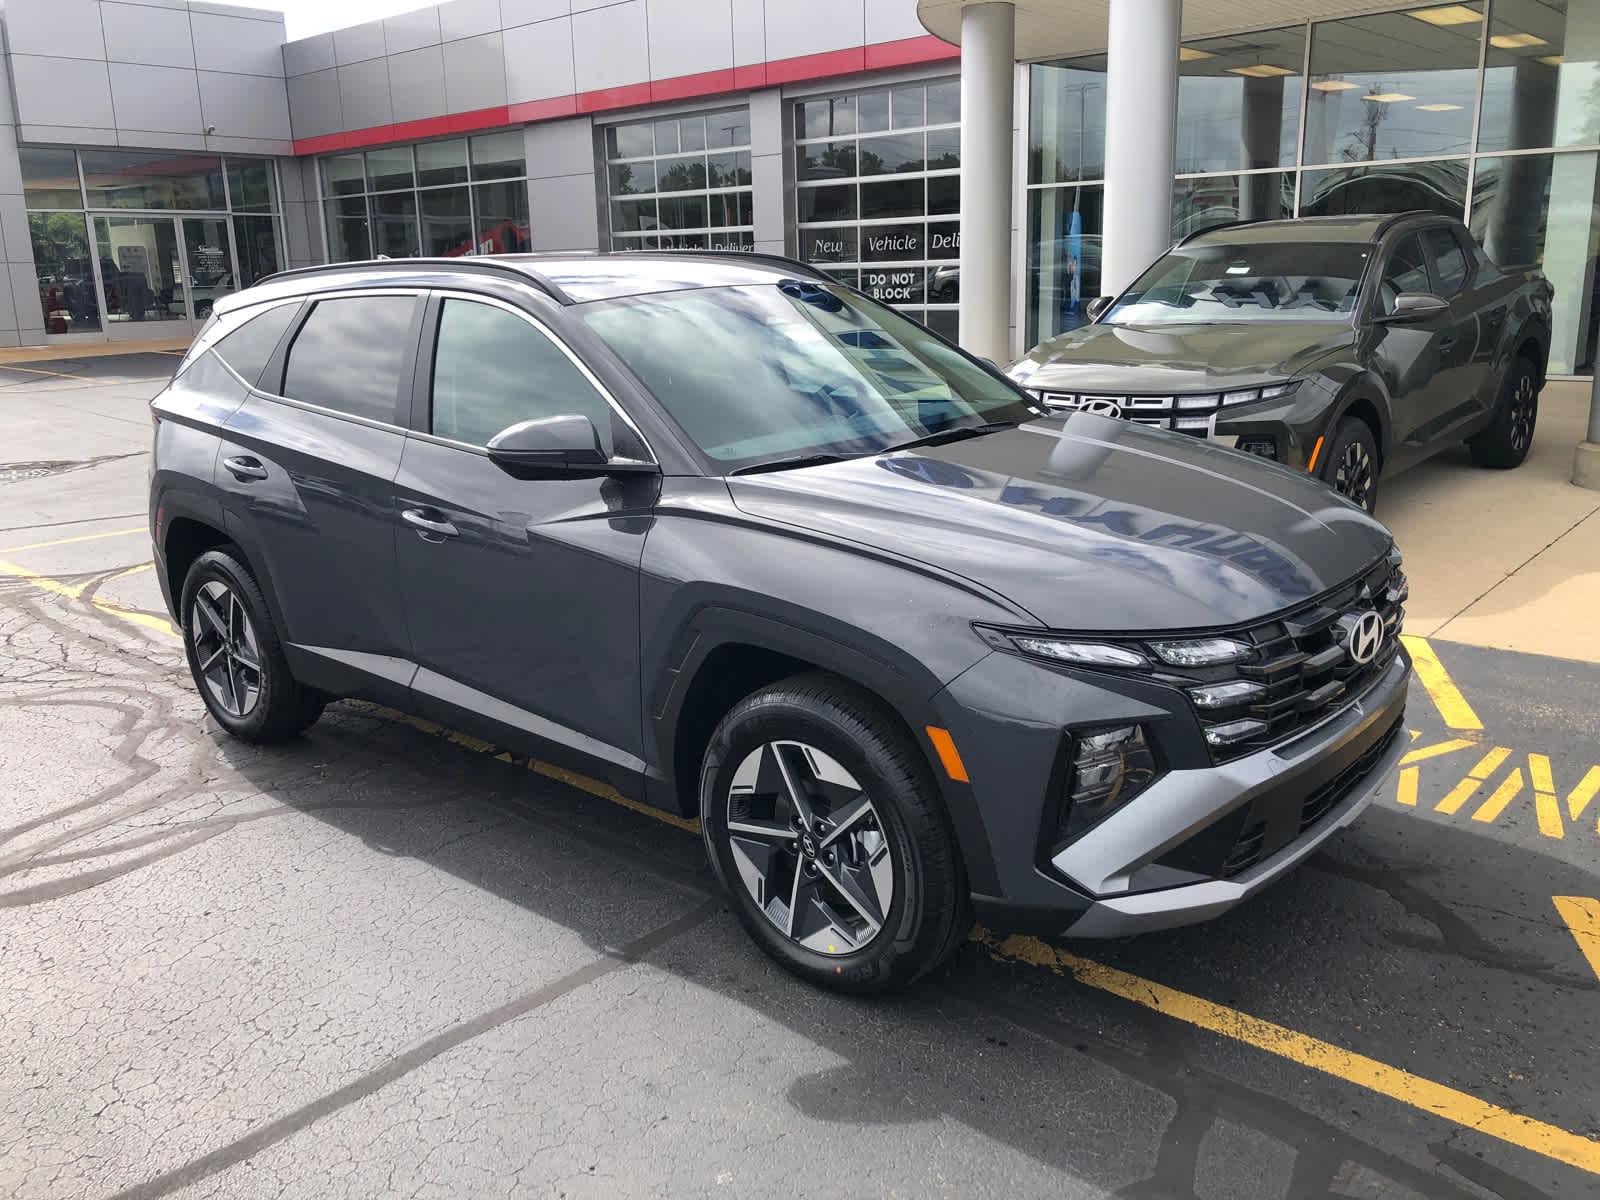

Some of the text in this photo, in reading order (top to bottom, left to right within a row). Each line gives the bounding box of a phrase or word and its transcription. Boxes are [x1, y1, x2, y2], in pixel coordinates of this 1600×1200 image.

[813, 239, 843, 254] New
[868, 234, 917, 251] Vehicle
[869, 272, 915, 286] DO NOT
[873, 287, 911, 300] BLOCK
